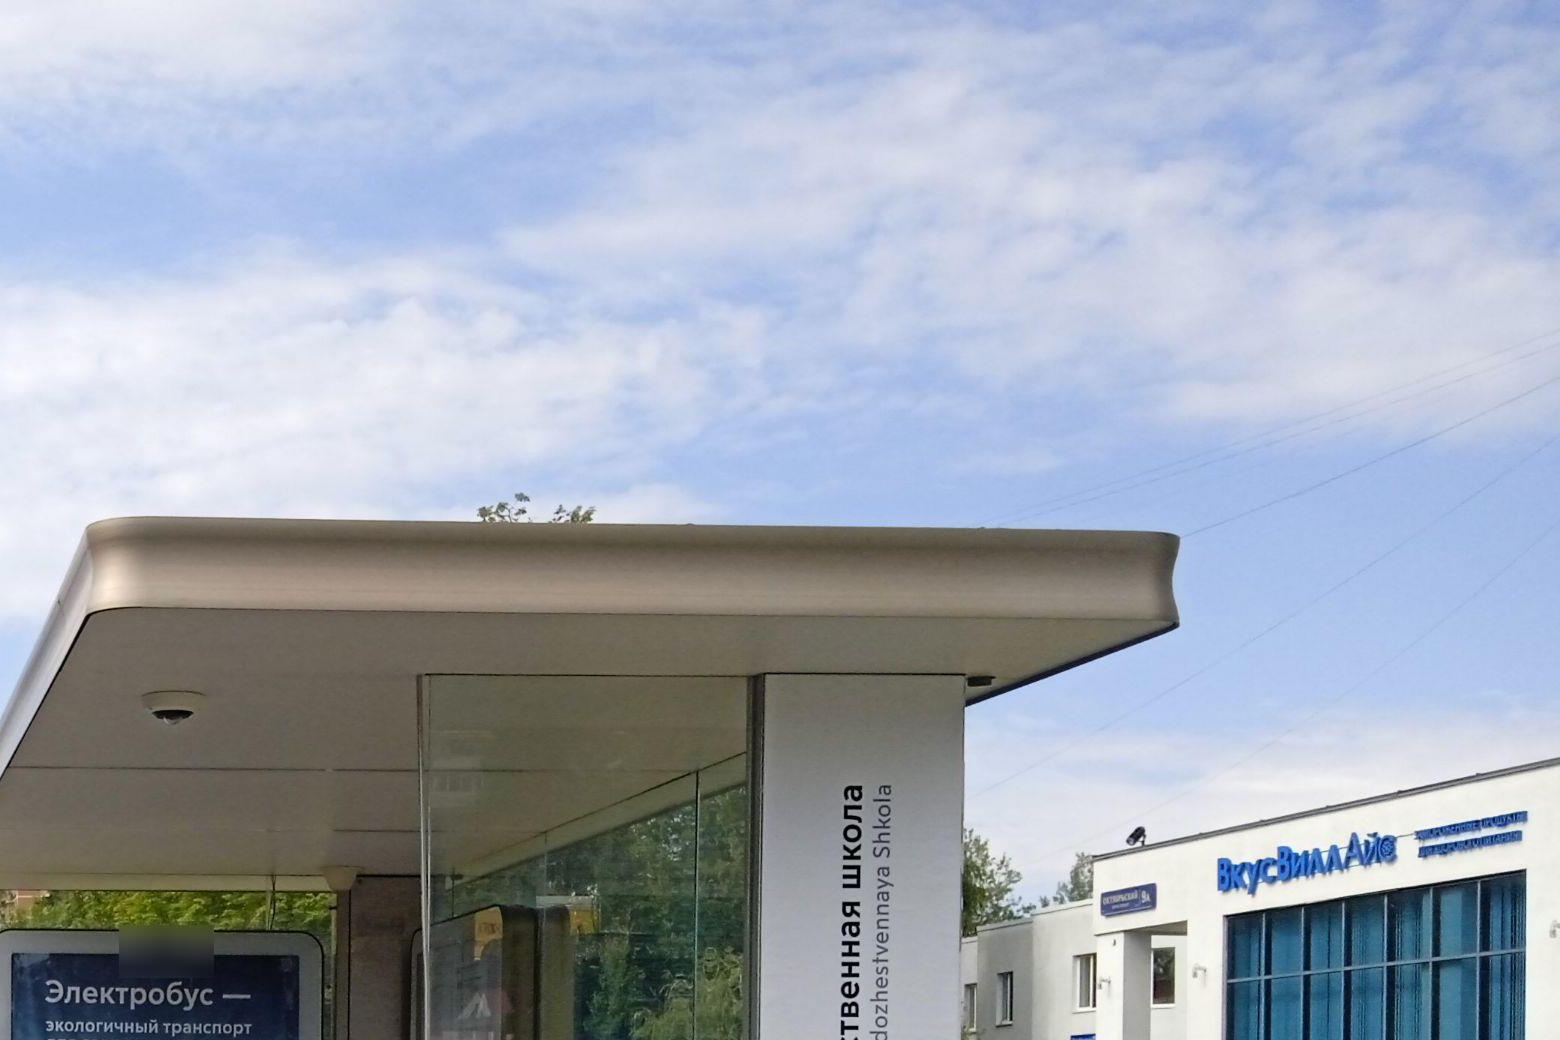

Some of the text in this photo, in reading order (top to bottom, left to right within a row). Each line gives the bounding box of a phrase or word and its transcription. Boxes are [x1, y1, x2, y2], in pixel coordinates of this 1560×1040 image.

[842, 784, 863, 889] школа
[872, 784, 892, 858] Shkola
[1216, 845, 1346, 896] ВкусВилл
[44, 979, 214, 1011] Электробус
[45, 1019, 252, 1036] экологичный транспорт
